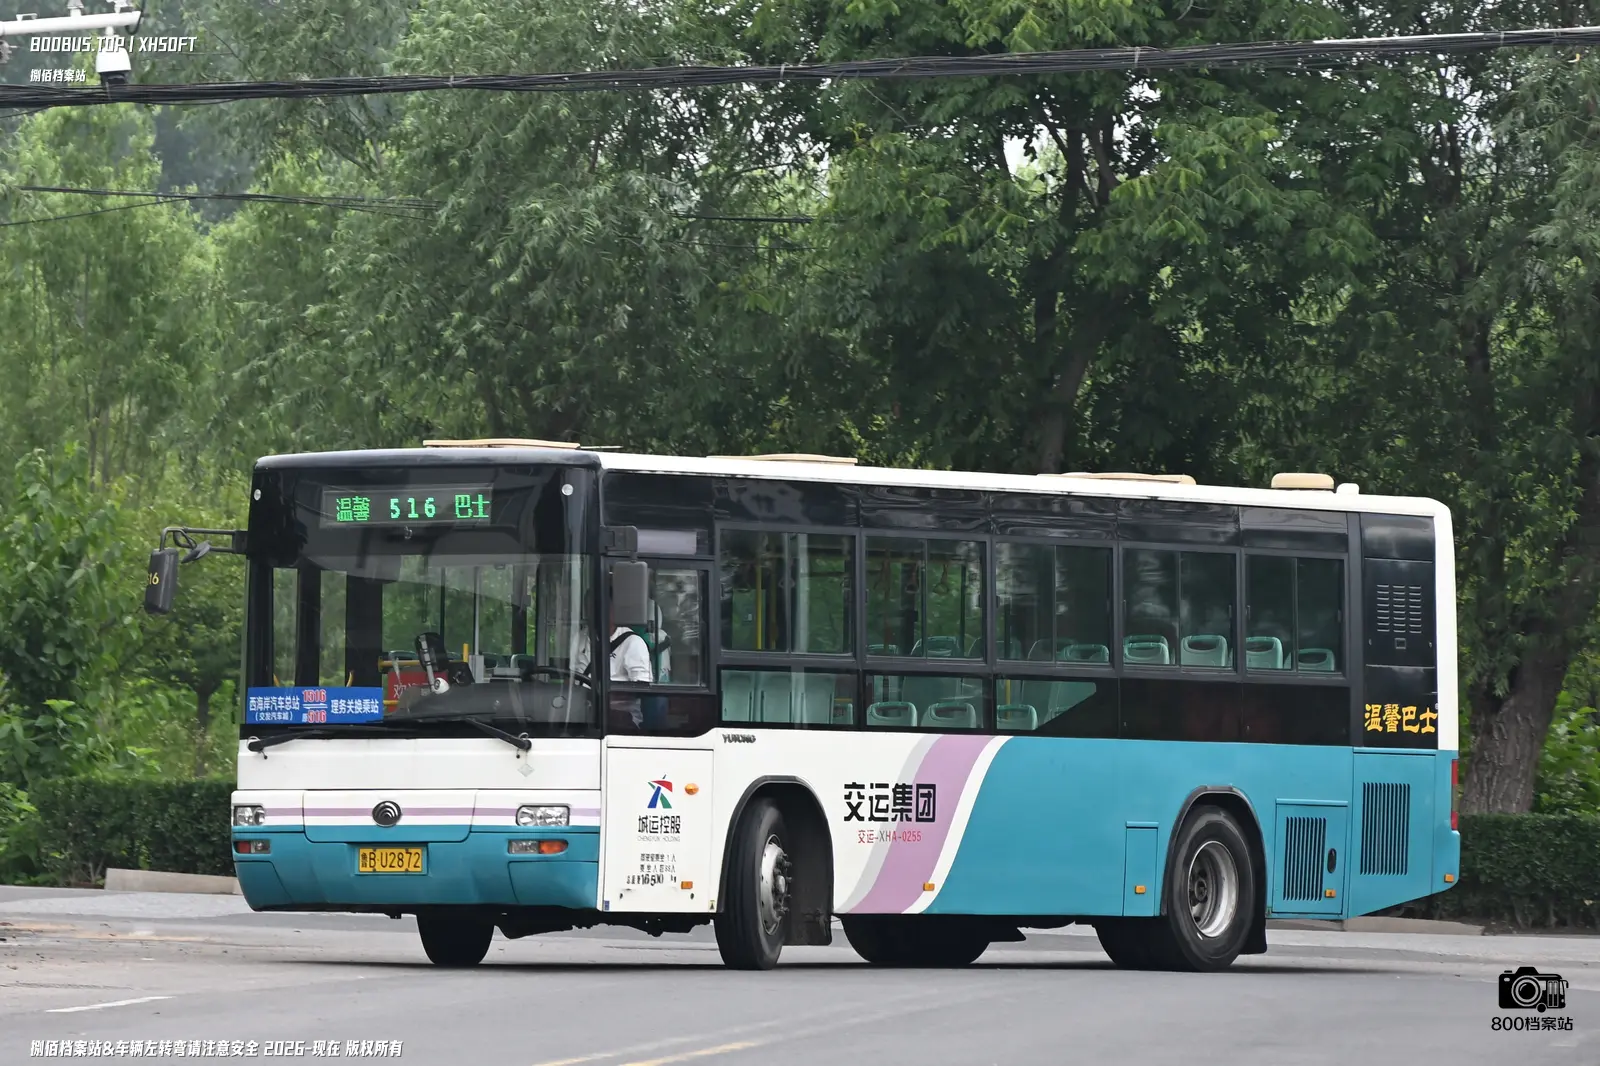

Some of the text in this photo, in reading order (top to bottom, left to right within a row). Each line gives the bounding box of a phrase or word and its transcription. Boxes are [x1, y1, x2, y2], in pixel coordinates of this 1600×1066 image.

[336, 494, 490, 521] 温馨 516 巴士
[148, 572, 160, 585] 16
[1364, 704, 1438, 733] 温馨巴士
[843, 782, 936, 822] 交运集团
[638, 815, 681, 834] 城运控股
